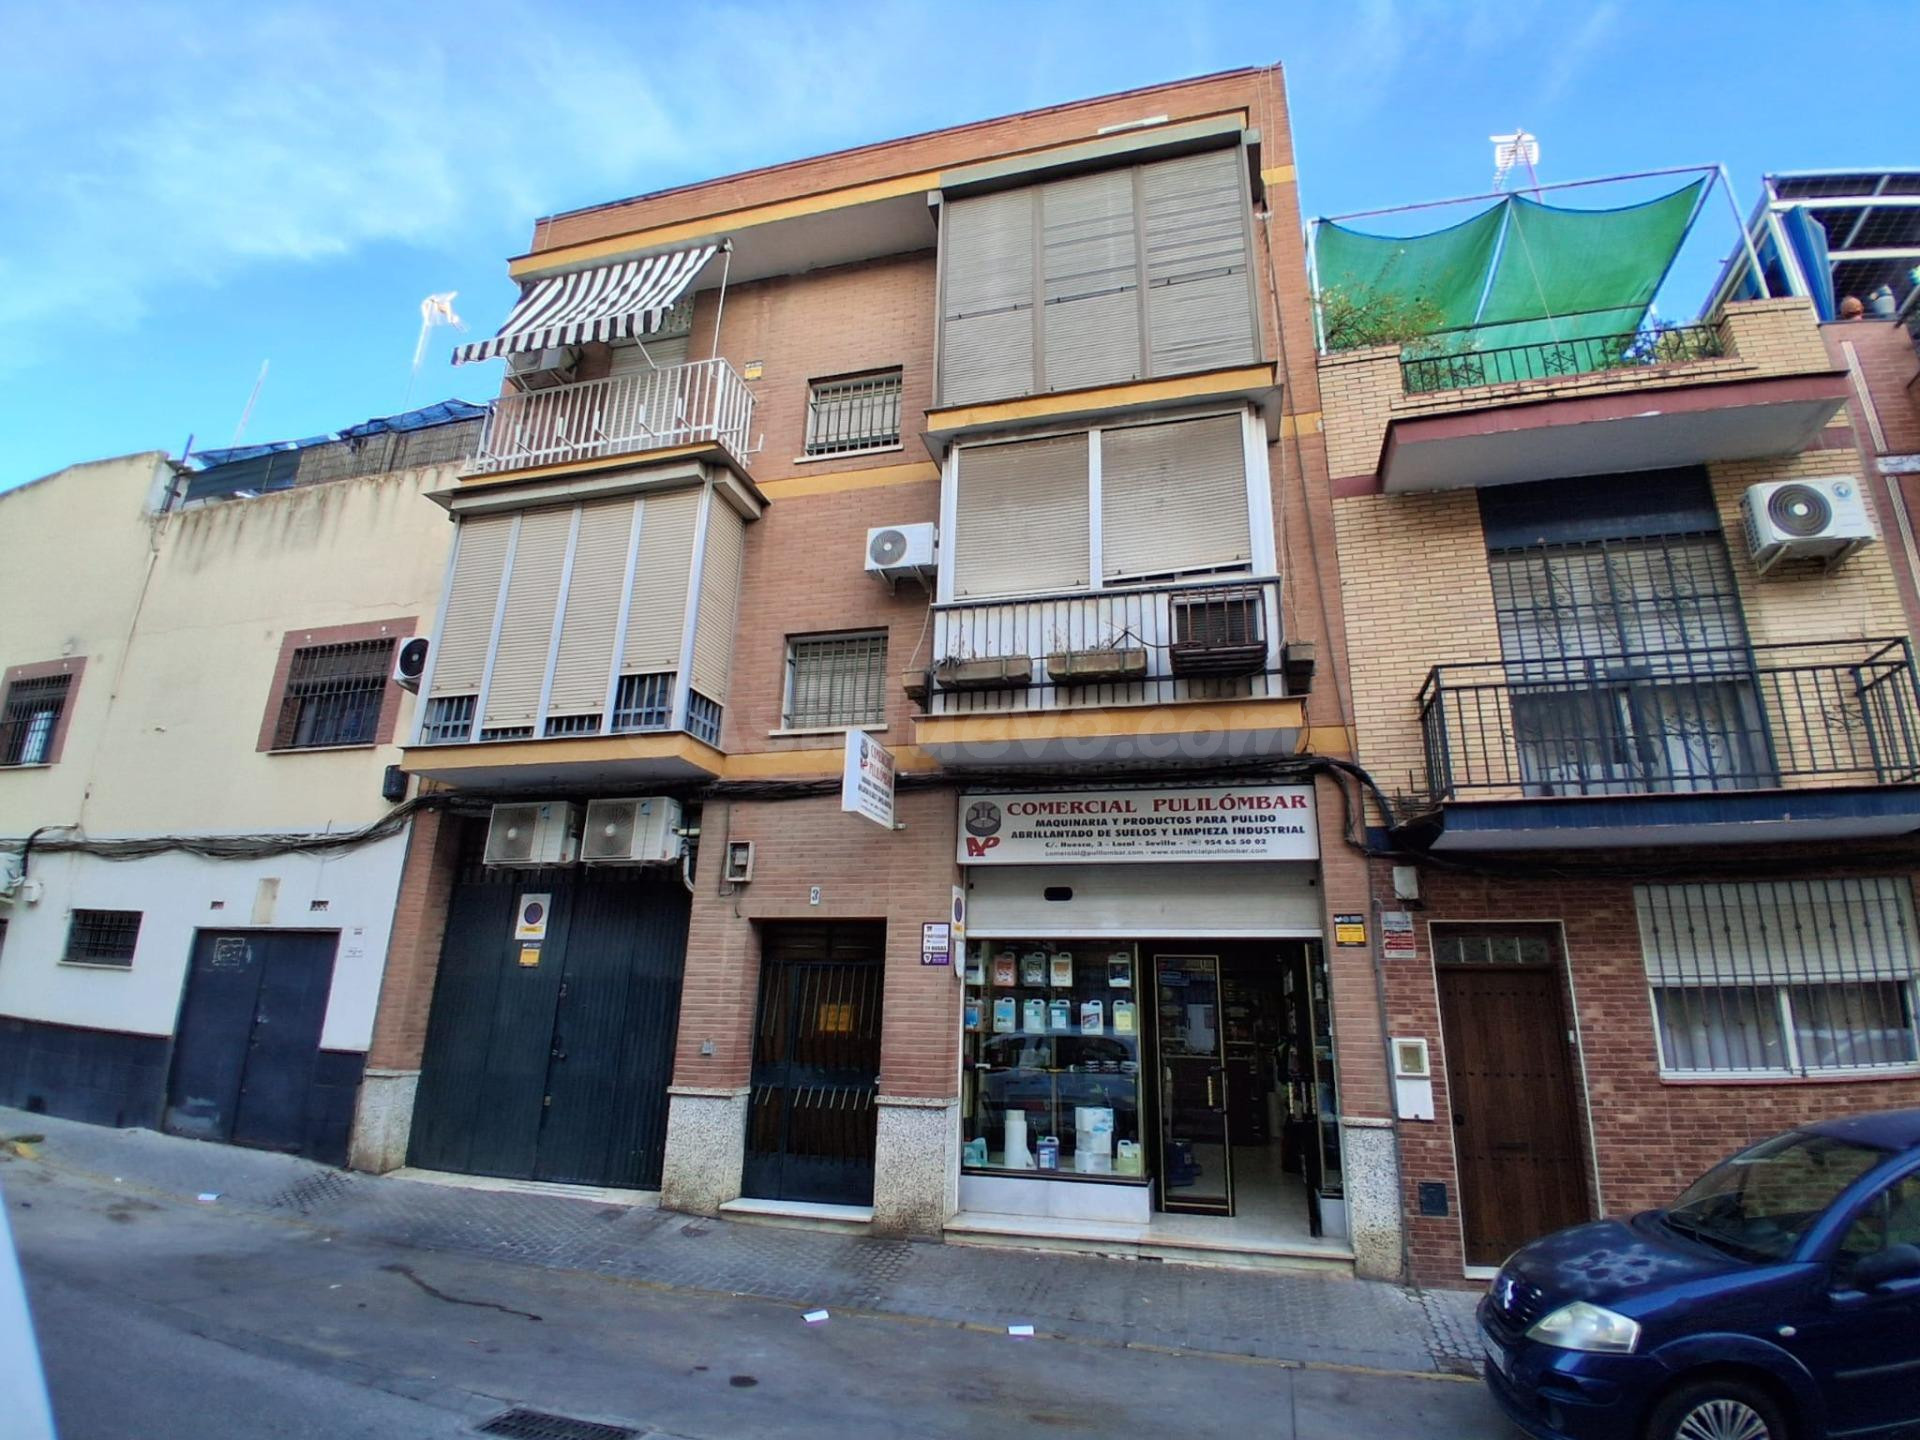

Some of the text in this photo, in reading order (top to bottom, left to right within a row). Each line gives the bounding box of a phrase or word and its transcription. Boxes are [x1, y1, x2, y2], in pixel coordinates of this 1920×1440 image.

[1007, 793, 1308, 816] COMERCIAL PULILÓMBAR
[1035, 814, 1276, 828] MAQUINARIA Y PRODUCTOS PARA PULIDO
[1011, 825, 1305, 839] ABRILLANTADO DE SUELOS Y LIMPIEZA INDUSTRIAL
[812, 889, 819, 901] 3
